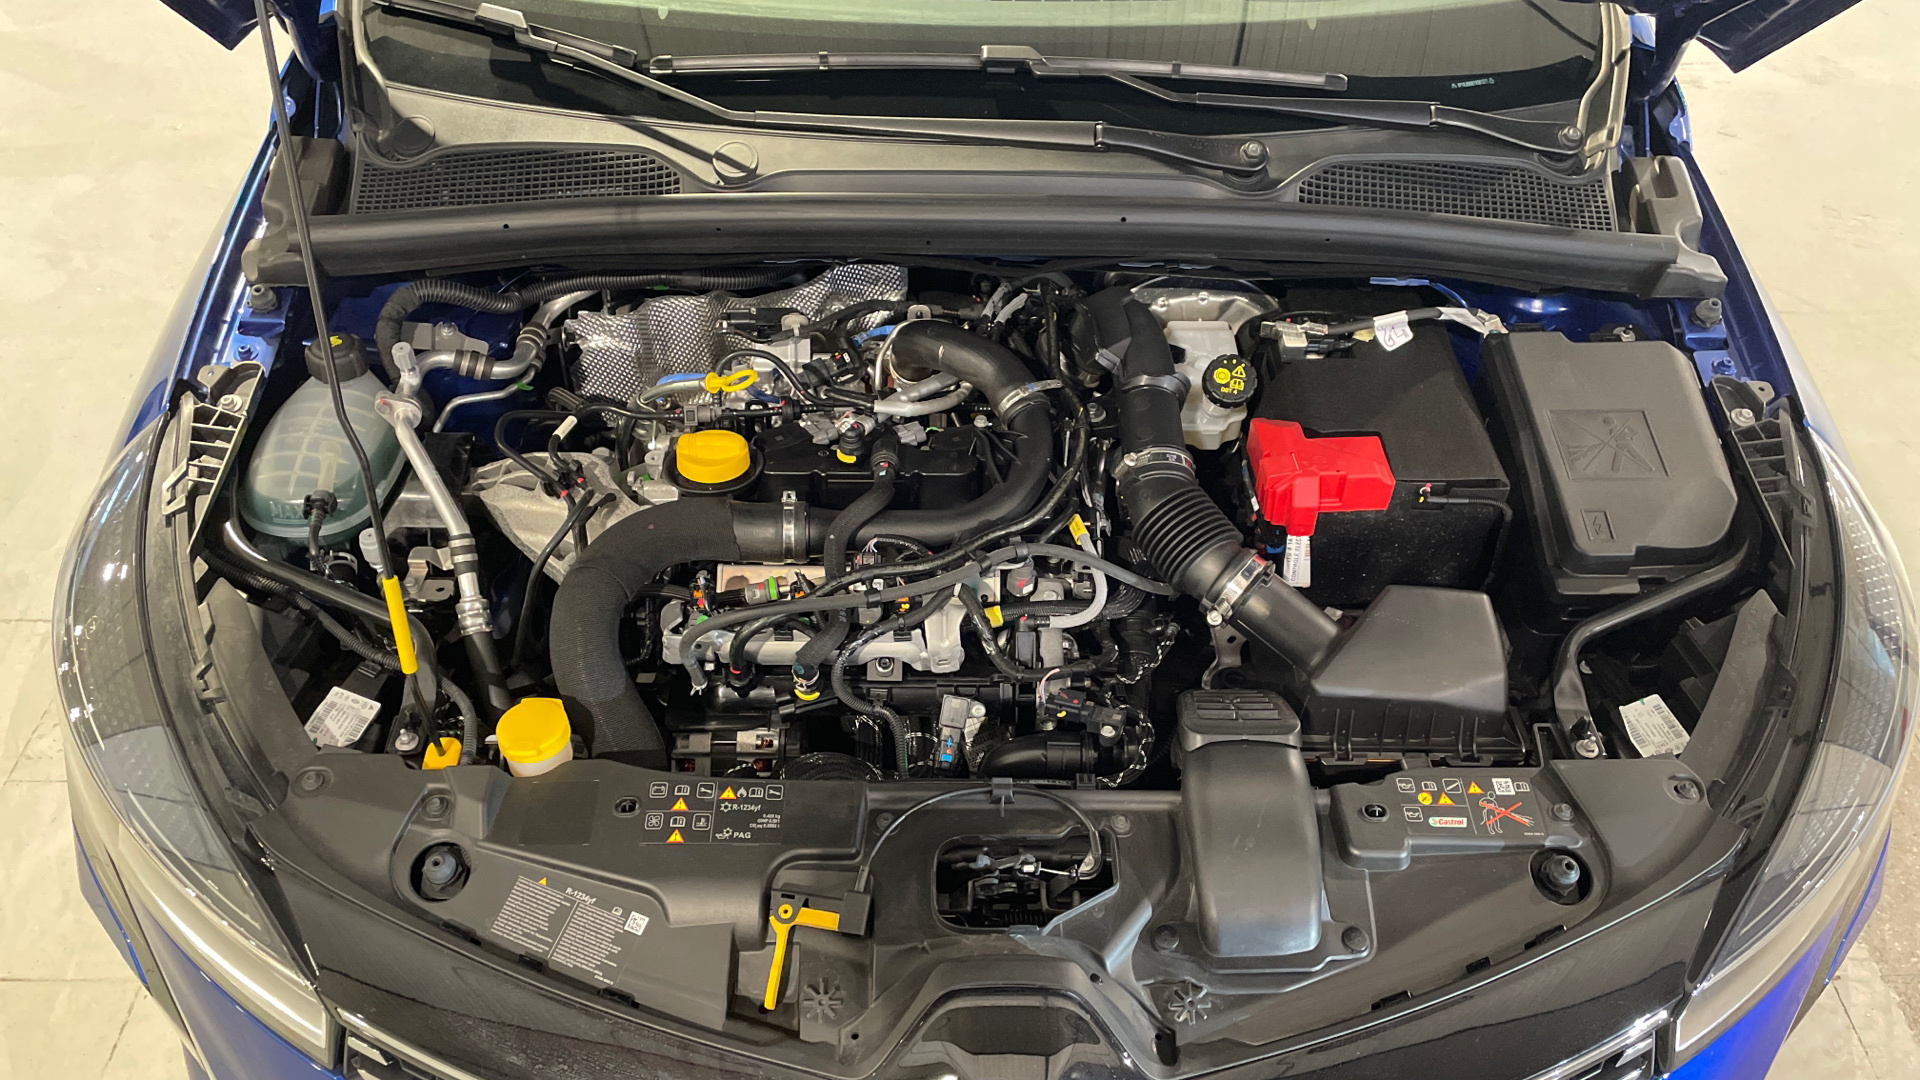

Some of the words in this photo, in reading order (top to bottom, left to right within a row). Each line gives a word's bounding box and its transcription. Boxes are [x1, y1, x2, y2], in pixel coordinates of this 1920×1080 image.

[1291, 552, 1299, 581] CONTROLE
[732, 804, 761, 812] R-1234yf
[1438, 817, 1464, 826] Castrol
[565, 887, 597, 905] R-1234yf
